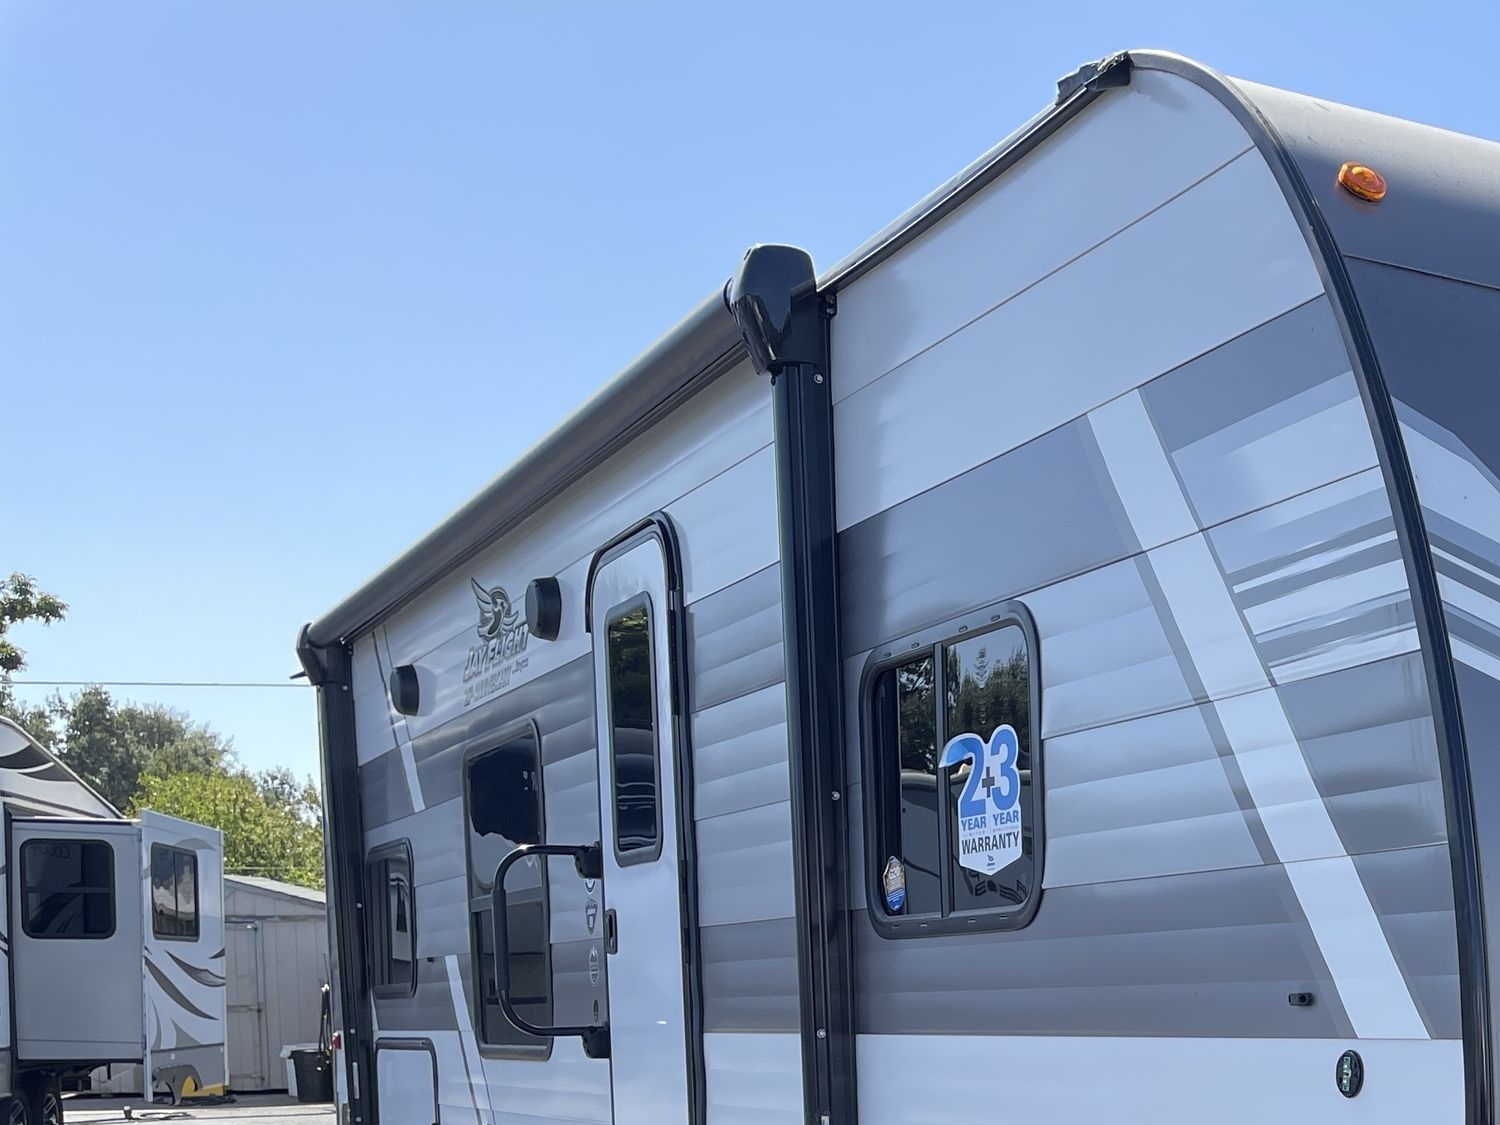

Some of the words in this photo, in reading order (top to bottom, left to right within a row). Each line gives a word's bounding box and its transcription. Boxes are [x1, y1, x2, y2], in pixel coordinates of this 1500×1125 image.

[487, 623, 529, 666] FLIGHT
[960, 816, 987, 831] YEAR
[992, 810, 1019, 826] YEAR
[961, 831, 1020, 855] WARRANTY
